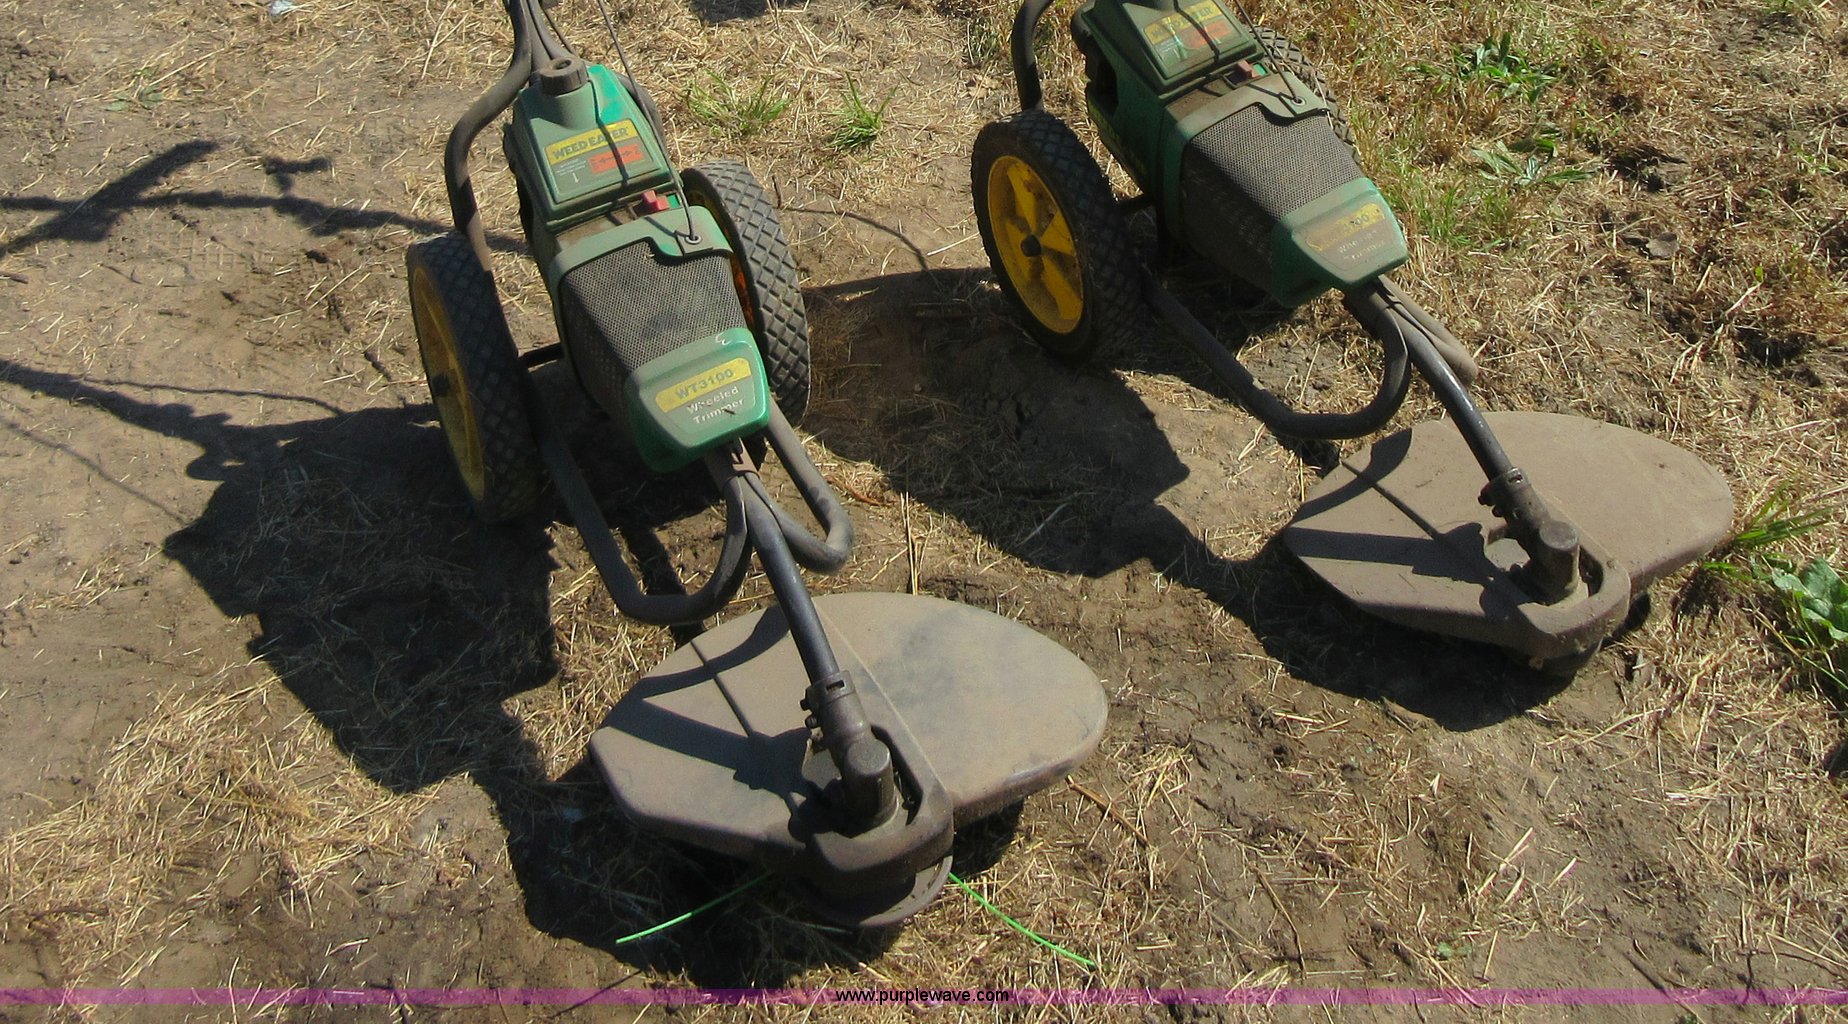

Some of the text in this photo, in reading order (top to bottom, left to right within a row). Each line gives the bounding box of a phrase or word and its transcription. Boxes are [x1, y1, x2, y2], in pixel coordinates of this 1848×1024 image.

[553, 139, 589, 160] WEED
[588, 127, 629, 147] EAER
[675, 368, 734, 400] WT3100
[686, 386, 739, 415] Wheeled
[693, 399, 745, 424] Trimmer
